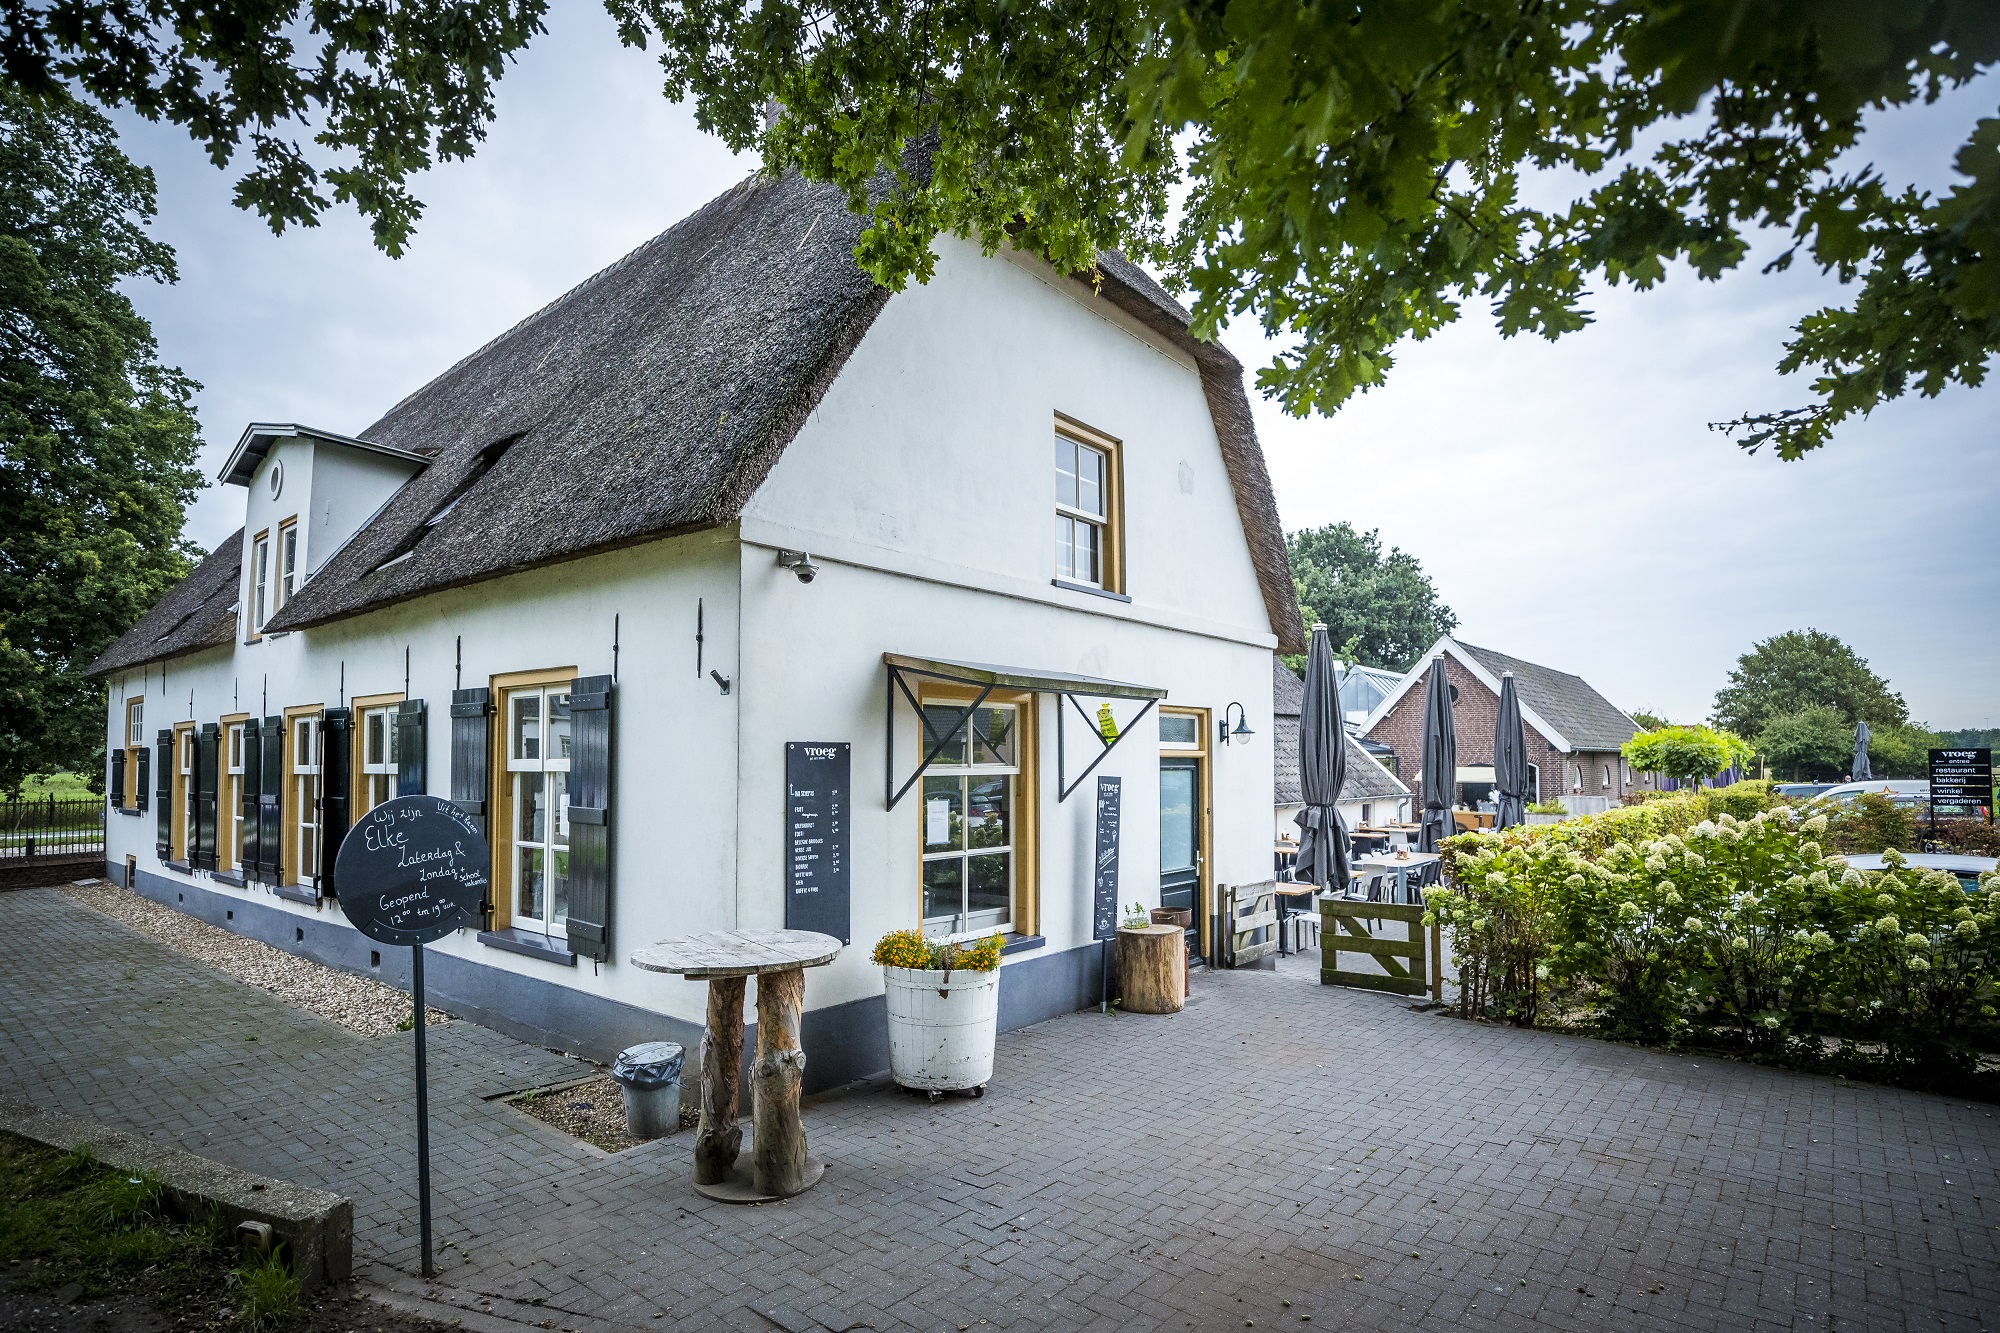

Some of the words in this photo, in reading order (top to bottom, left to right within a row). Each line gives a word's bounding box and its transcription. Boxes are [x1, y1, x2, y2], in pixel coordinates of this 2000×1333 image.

[804, 747, 837, 760] vroeg
[1941, 751, 1977, 759] vroeg
[374, 810, 395, 826] Wij
[400, 806, 423, 822] zijn
[437, 801, 450, 814] Uit
[450, 807, 465, 819] het
[364, 825, 409, 851] Elke
[397, 844, 454, 867] Zaterdag
[455, 841, 466, 857] &
[419, 866, 458, 882] Zondag
[379, 885, 430, 910] Geopend
